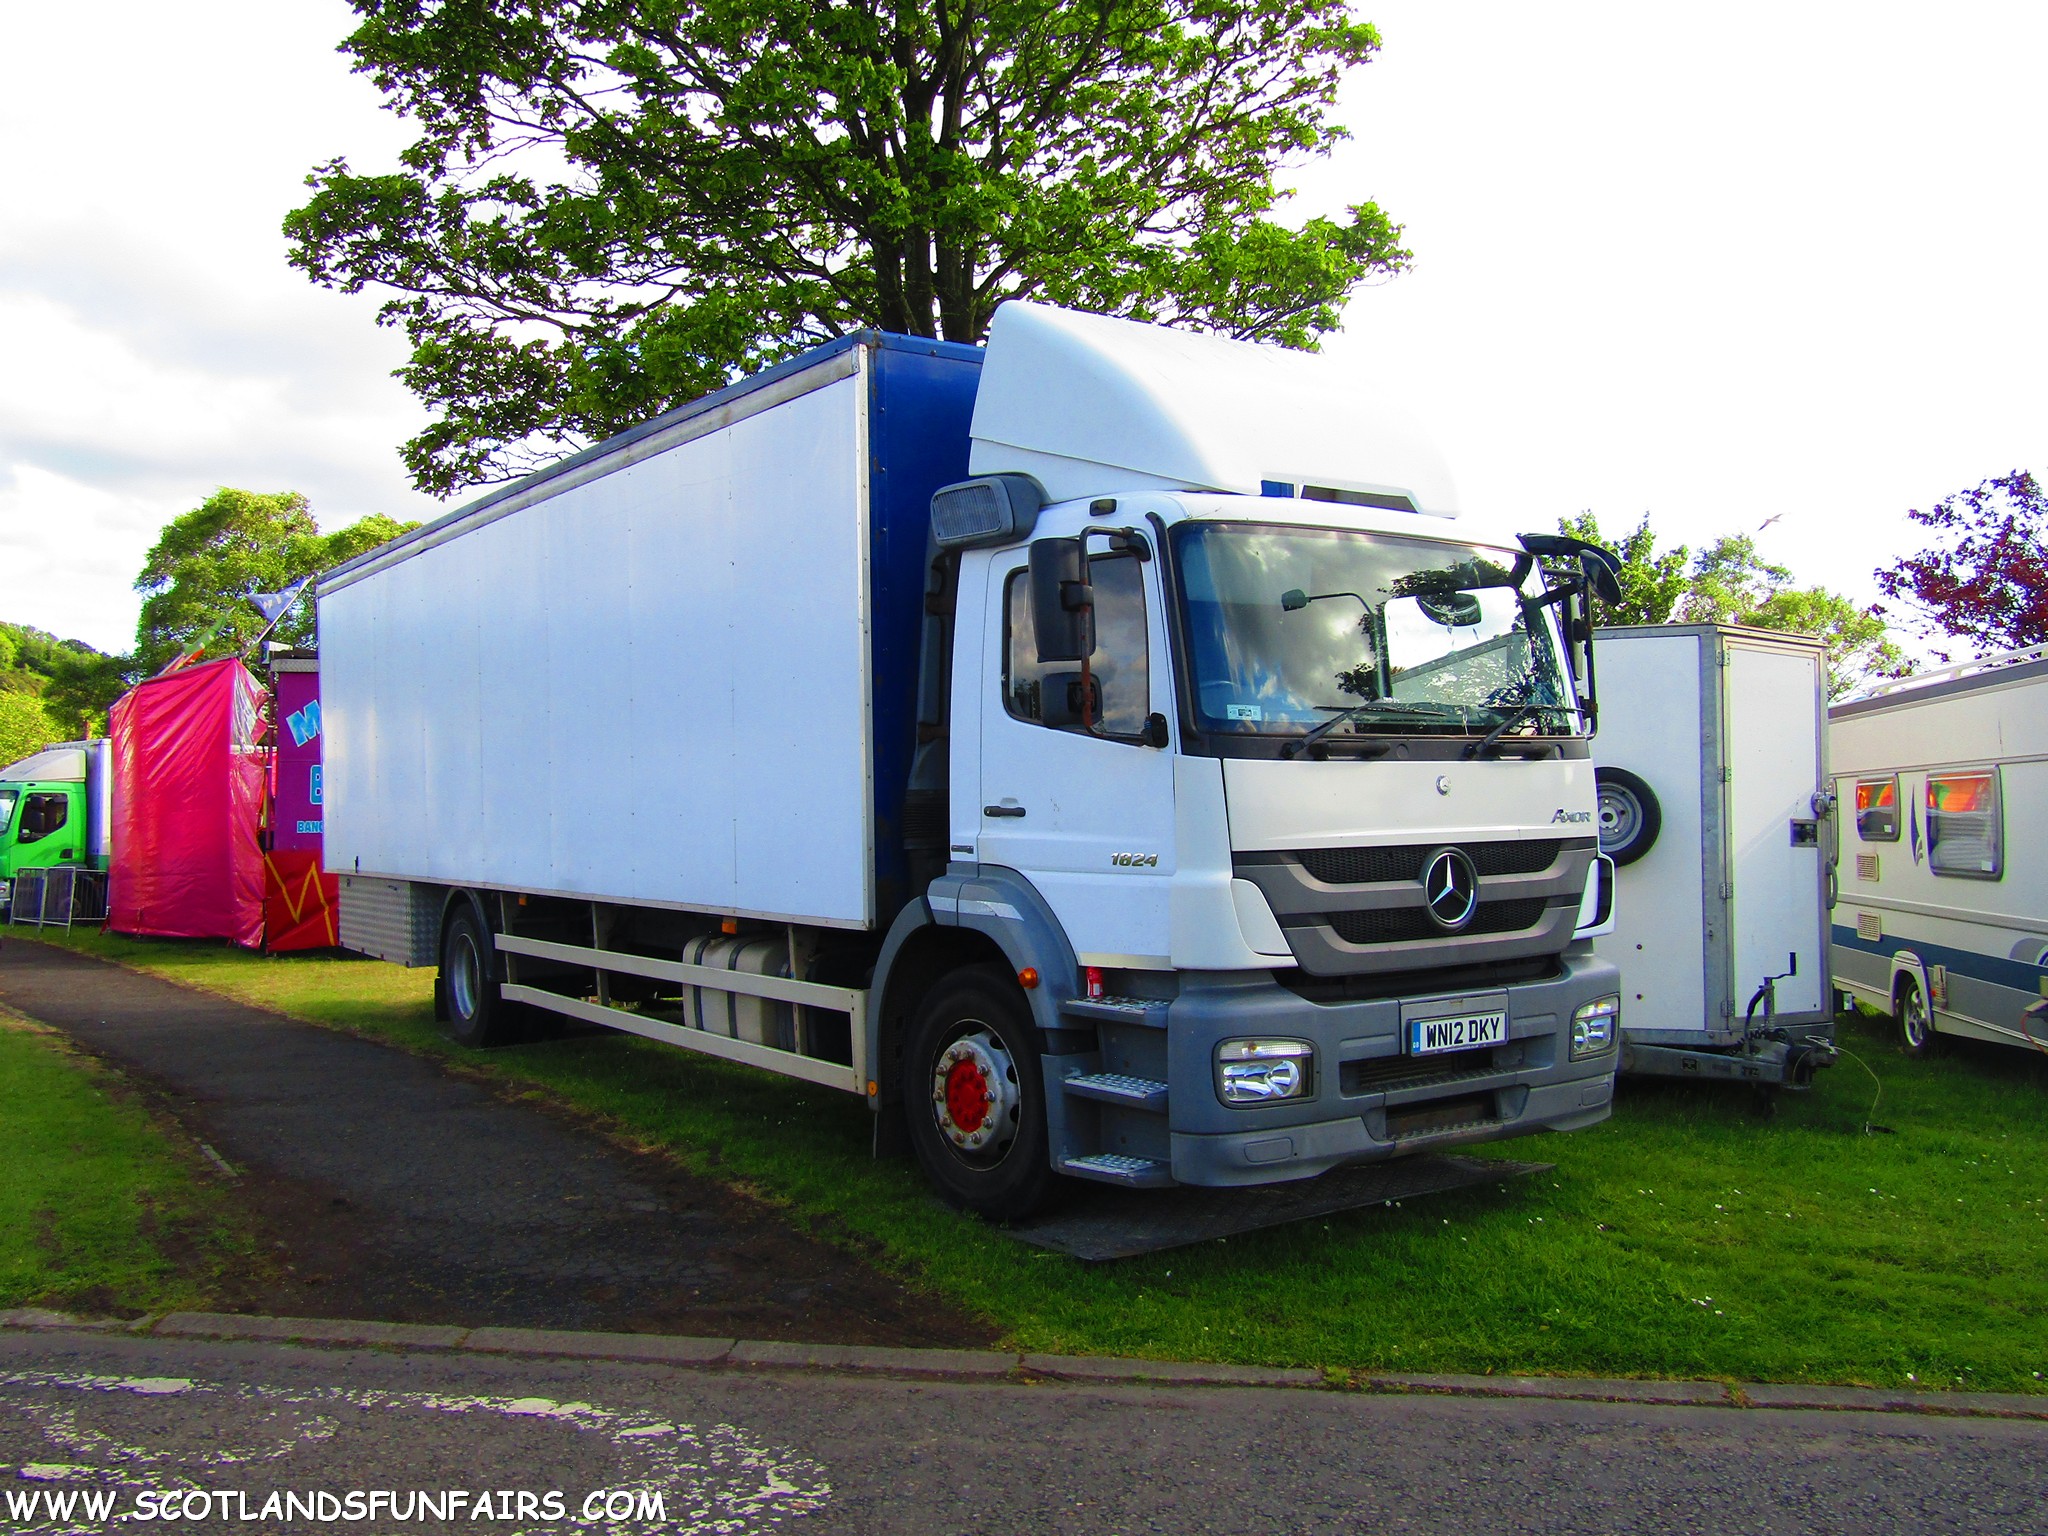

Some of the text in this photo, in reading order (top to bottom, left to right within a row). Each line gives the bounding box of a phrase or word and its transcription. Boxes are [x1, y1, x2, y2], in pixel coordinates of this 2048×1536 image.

[1111, 852, 1158, 868] 1824
[1426, 1016, 1500, 1048] WN12 DKY
